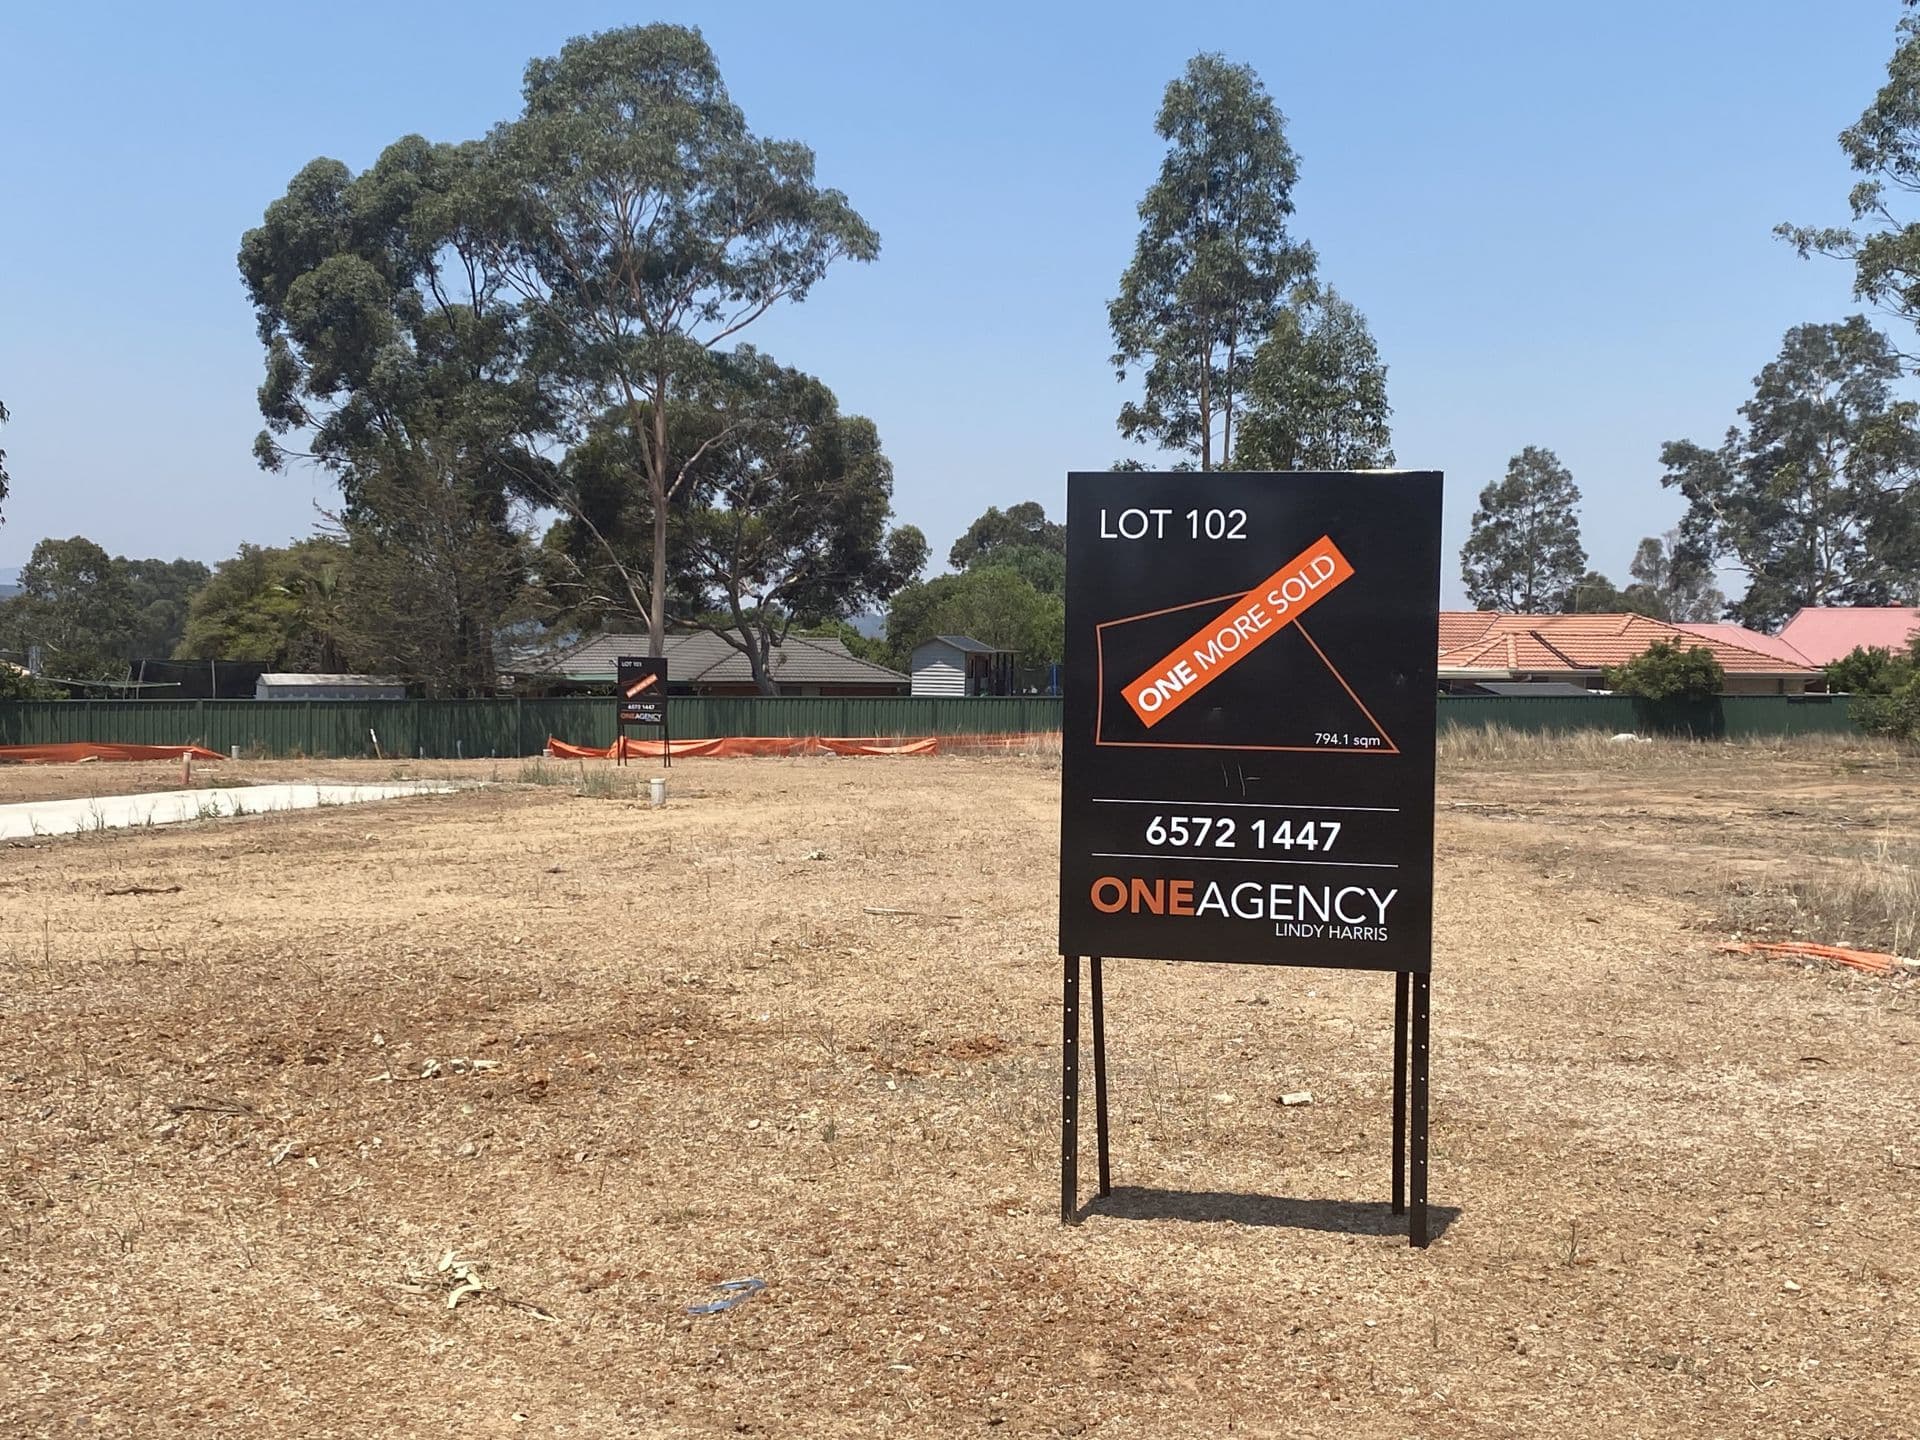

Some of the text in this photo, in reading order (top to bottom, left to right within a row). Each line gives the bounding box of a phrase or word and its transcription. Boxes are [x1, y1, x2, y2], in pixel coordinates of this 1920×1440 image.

[1099, 508, 1248, 540] LOT 102
[1138, 552, 1336, 713] ONE MORE SOLD
[1314, 731, 1381, 749] 794.1 sqm
[1145, 815, 1342, 852] 6572 1447
[1275, 922, 1389, 943] LINDY HARRIS
